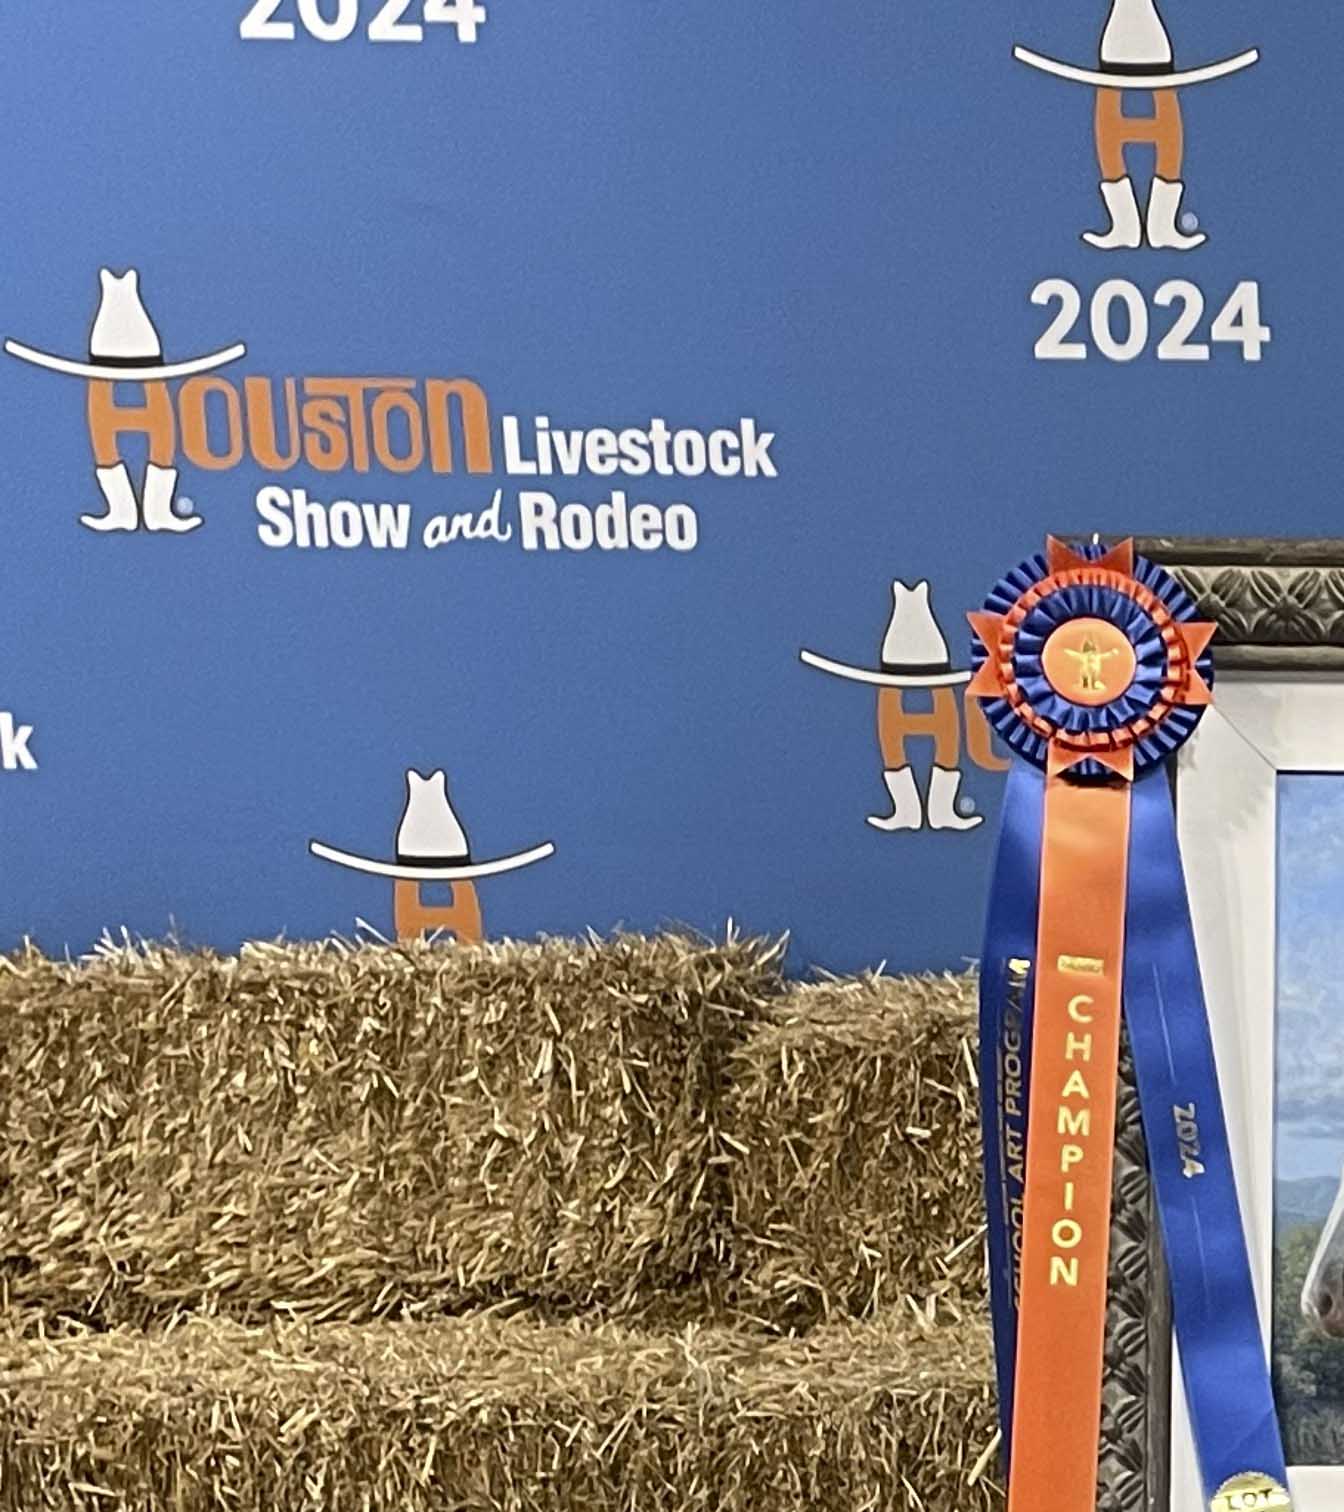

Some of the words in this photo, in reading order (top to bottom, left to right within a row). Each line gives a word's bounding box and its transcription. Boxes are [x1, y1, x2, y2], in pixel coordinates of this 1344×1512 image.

[1030, 278, 1271, 362] 2024
[502, 415, 778, 477] Livestock
[257, 486, 411, 549] Show
[423, 488, 511, 549] and
[519, 490, 698, 551] Rodeo
[1005, 1122, 1026, 1185] ART
[1049, 994, 1095, 1287] CHAMPION
[1172, 1102, 1206, 1179] 2024
